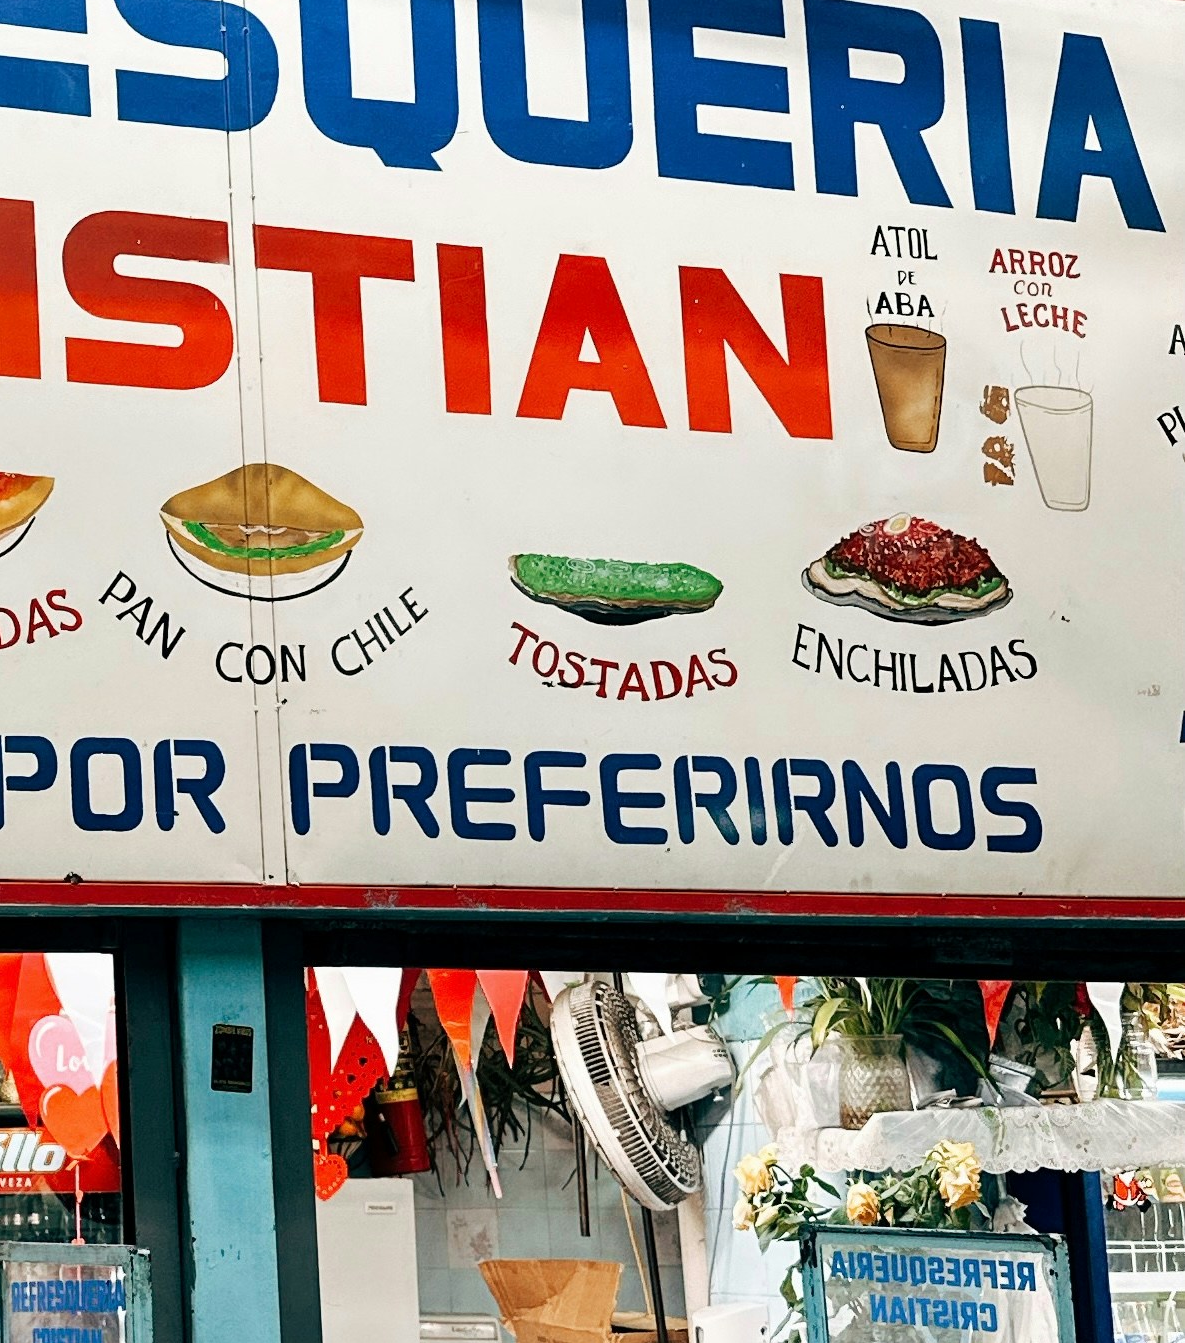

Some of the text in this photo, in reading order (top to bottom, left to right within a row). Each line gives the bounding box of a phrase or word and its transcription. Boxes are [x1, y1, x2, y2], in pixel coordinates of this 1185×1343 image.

[870, 224, 938, 261] ATOL
[897, 270, 918, 286] DE
[988, 248, 1081, 279] ARROZ
[874, 291, 935, 318] ABA
[1000, 302, 1089, 340] LECHE
[98, 571, 430, 686] PAN CON CHILE
[509, 622, 739, 702] TOSTADAS
[791, 623, 1039, 695] ENCHILADAS
[288, 742, 1045, 854] PREFERIRNOS
